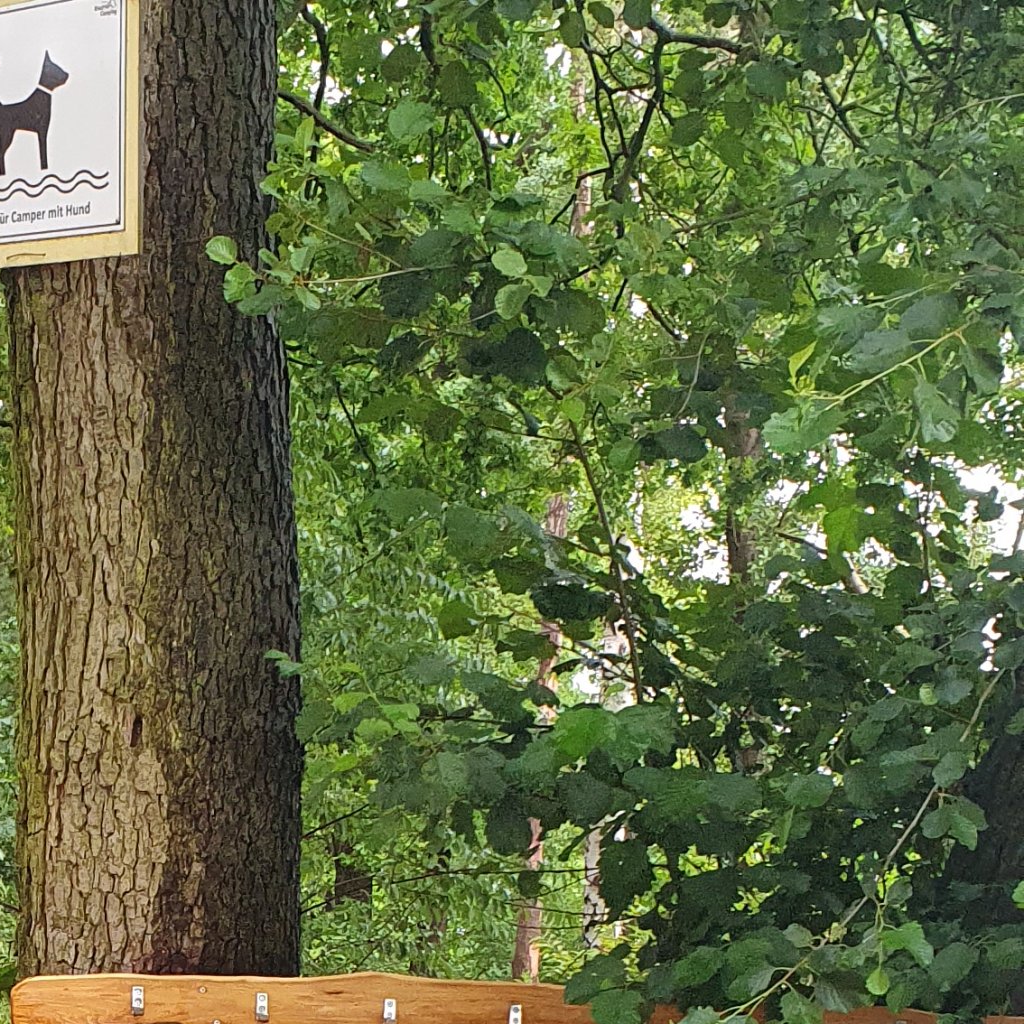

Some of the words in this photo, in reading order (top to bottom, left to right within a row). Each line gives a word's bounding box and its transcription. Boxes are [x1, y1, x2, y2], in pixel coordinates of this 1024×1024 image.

[11, 210, 46, 223] Camper
[48, 205, 64, 218] mit
[66, 201, 91, 216] Hund
